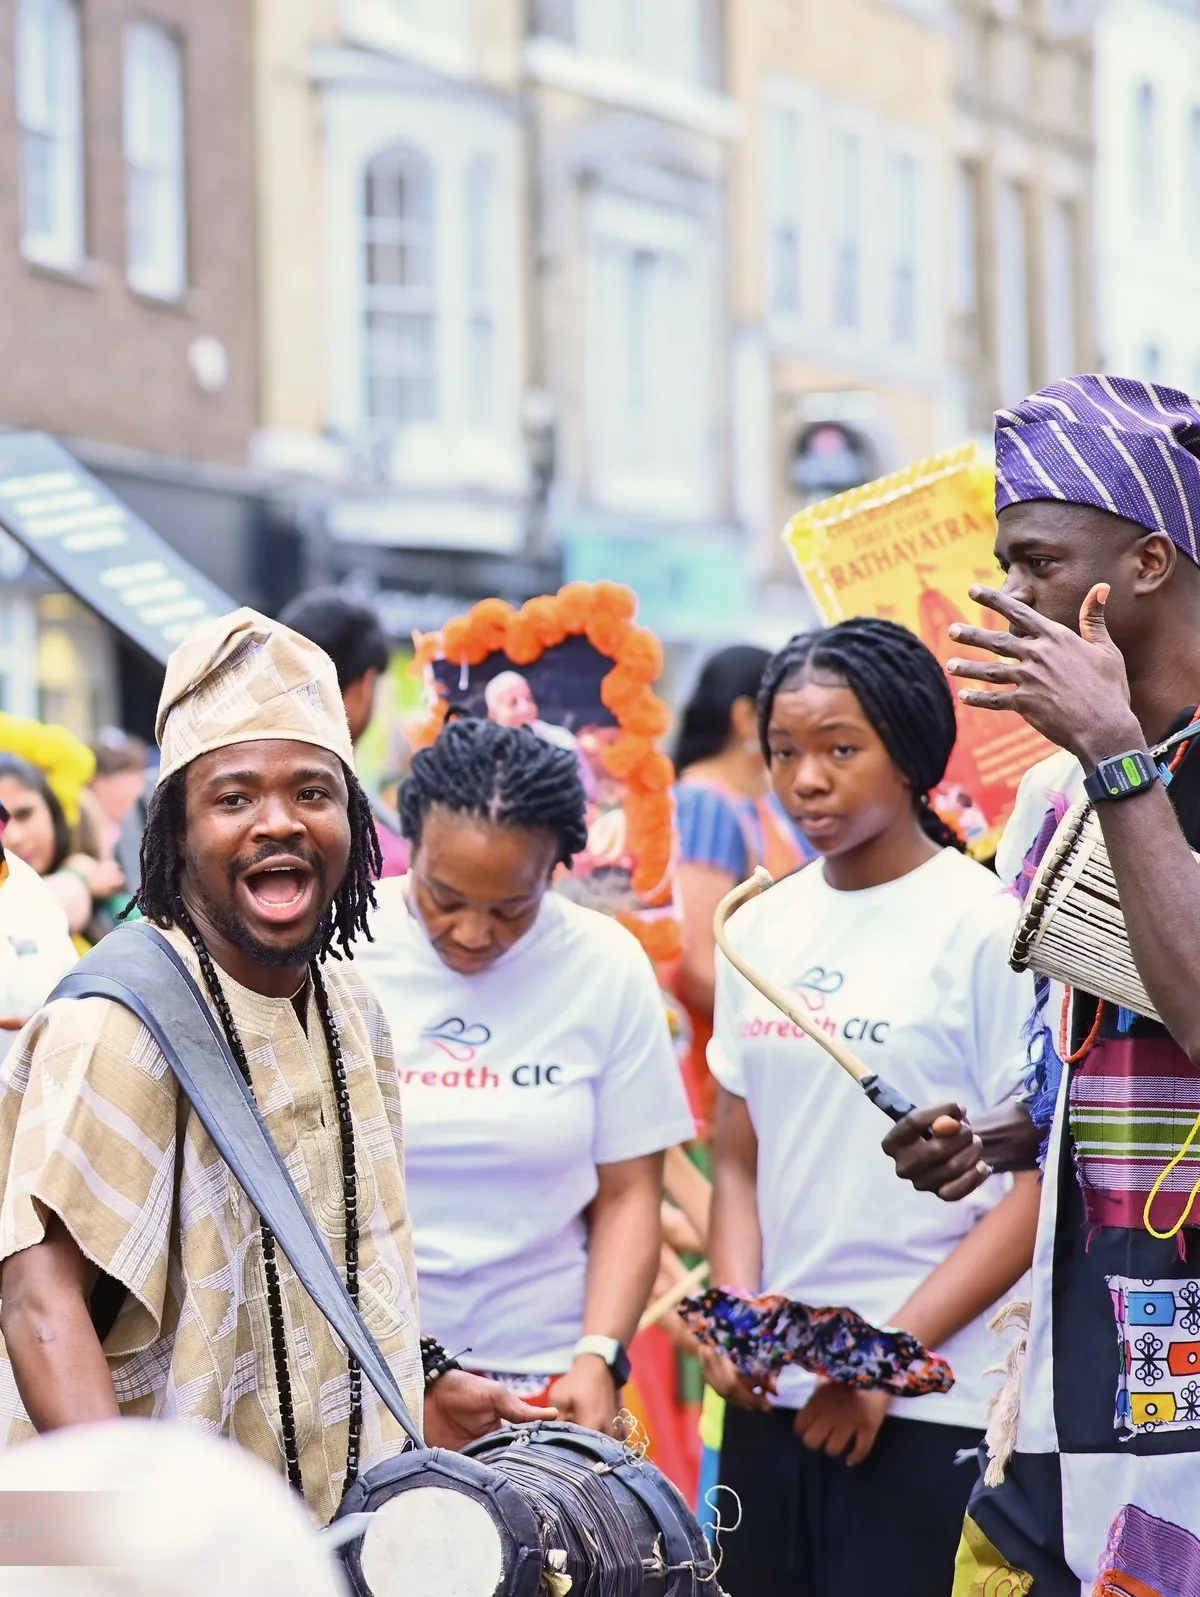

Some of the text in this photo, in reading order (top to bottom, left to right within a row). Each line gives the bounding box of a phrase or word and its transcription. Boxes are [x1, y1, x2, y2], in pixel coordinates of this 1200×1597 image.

[829, 512, 981, 590] RATHAYATRA
[843, 1017, 890, 1044] CIC
[511, 1065, 562, 1087] CIC
